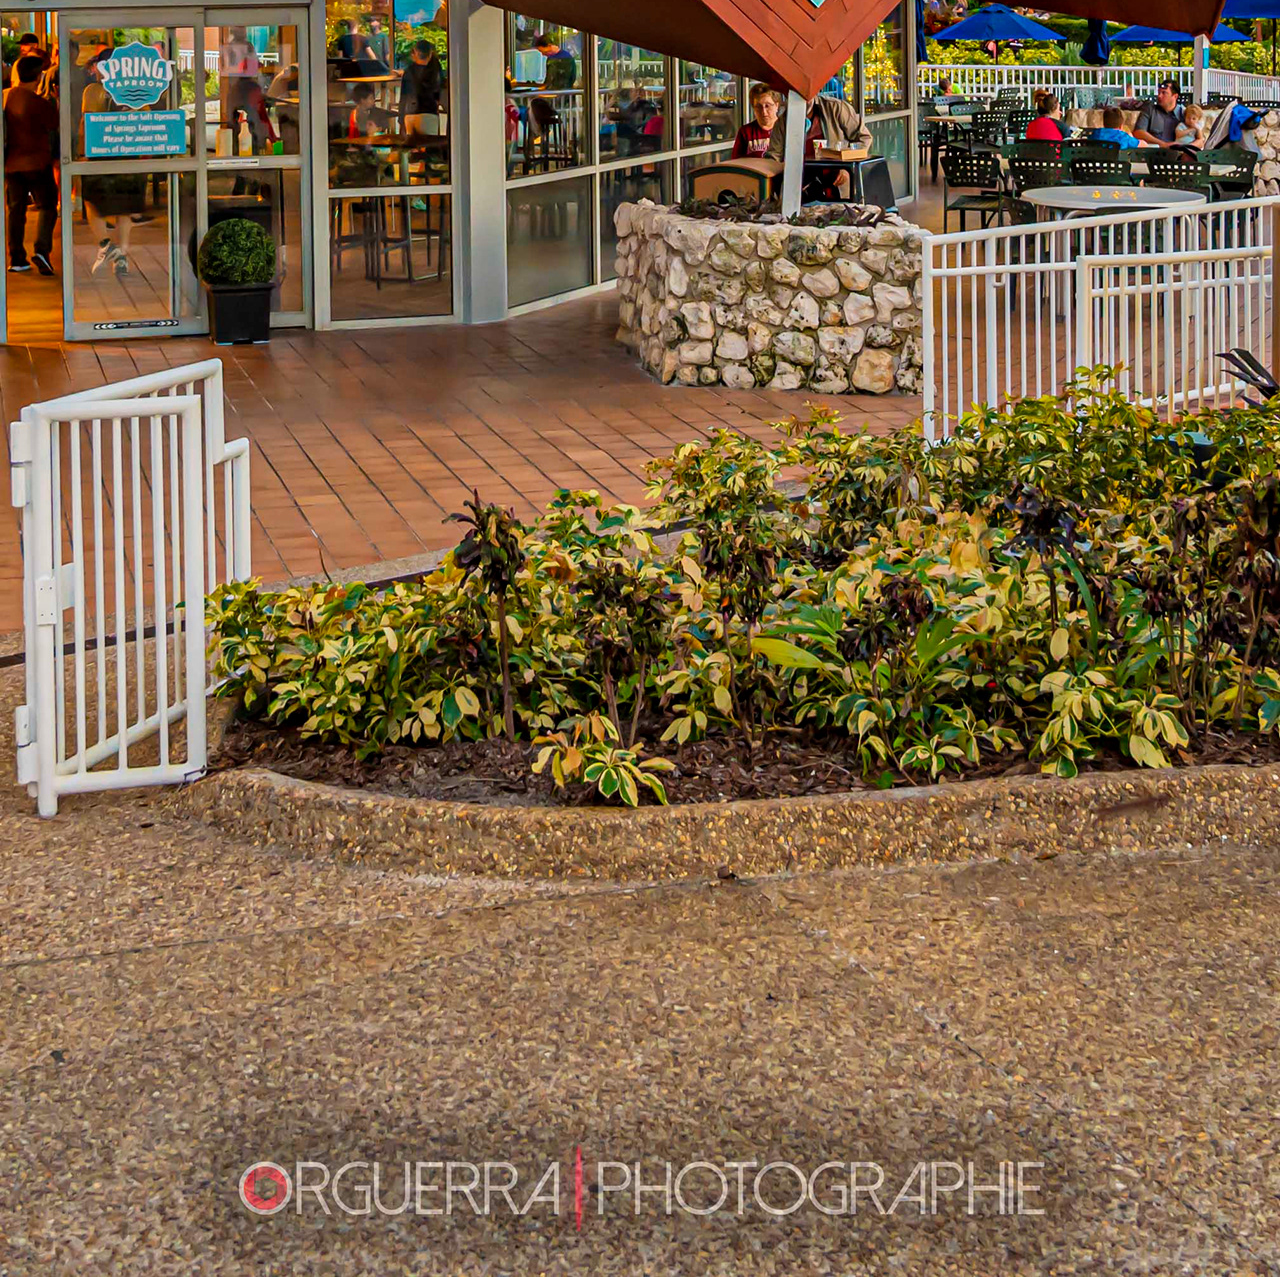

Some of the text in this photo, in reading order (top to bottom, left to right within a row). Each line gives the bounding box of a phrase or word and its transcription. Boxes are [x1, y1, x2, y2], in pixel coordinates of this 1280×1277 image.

[97, 56, 176, 82] SPRINGS
[110, 80, 163, 88] TAPROOM
[90, 114, 118, 122] Welcome
[120, 114, 127, 122] to
[128, 113, 138, 122] the
[103, 135, 123, 143] Please
